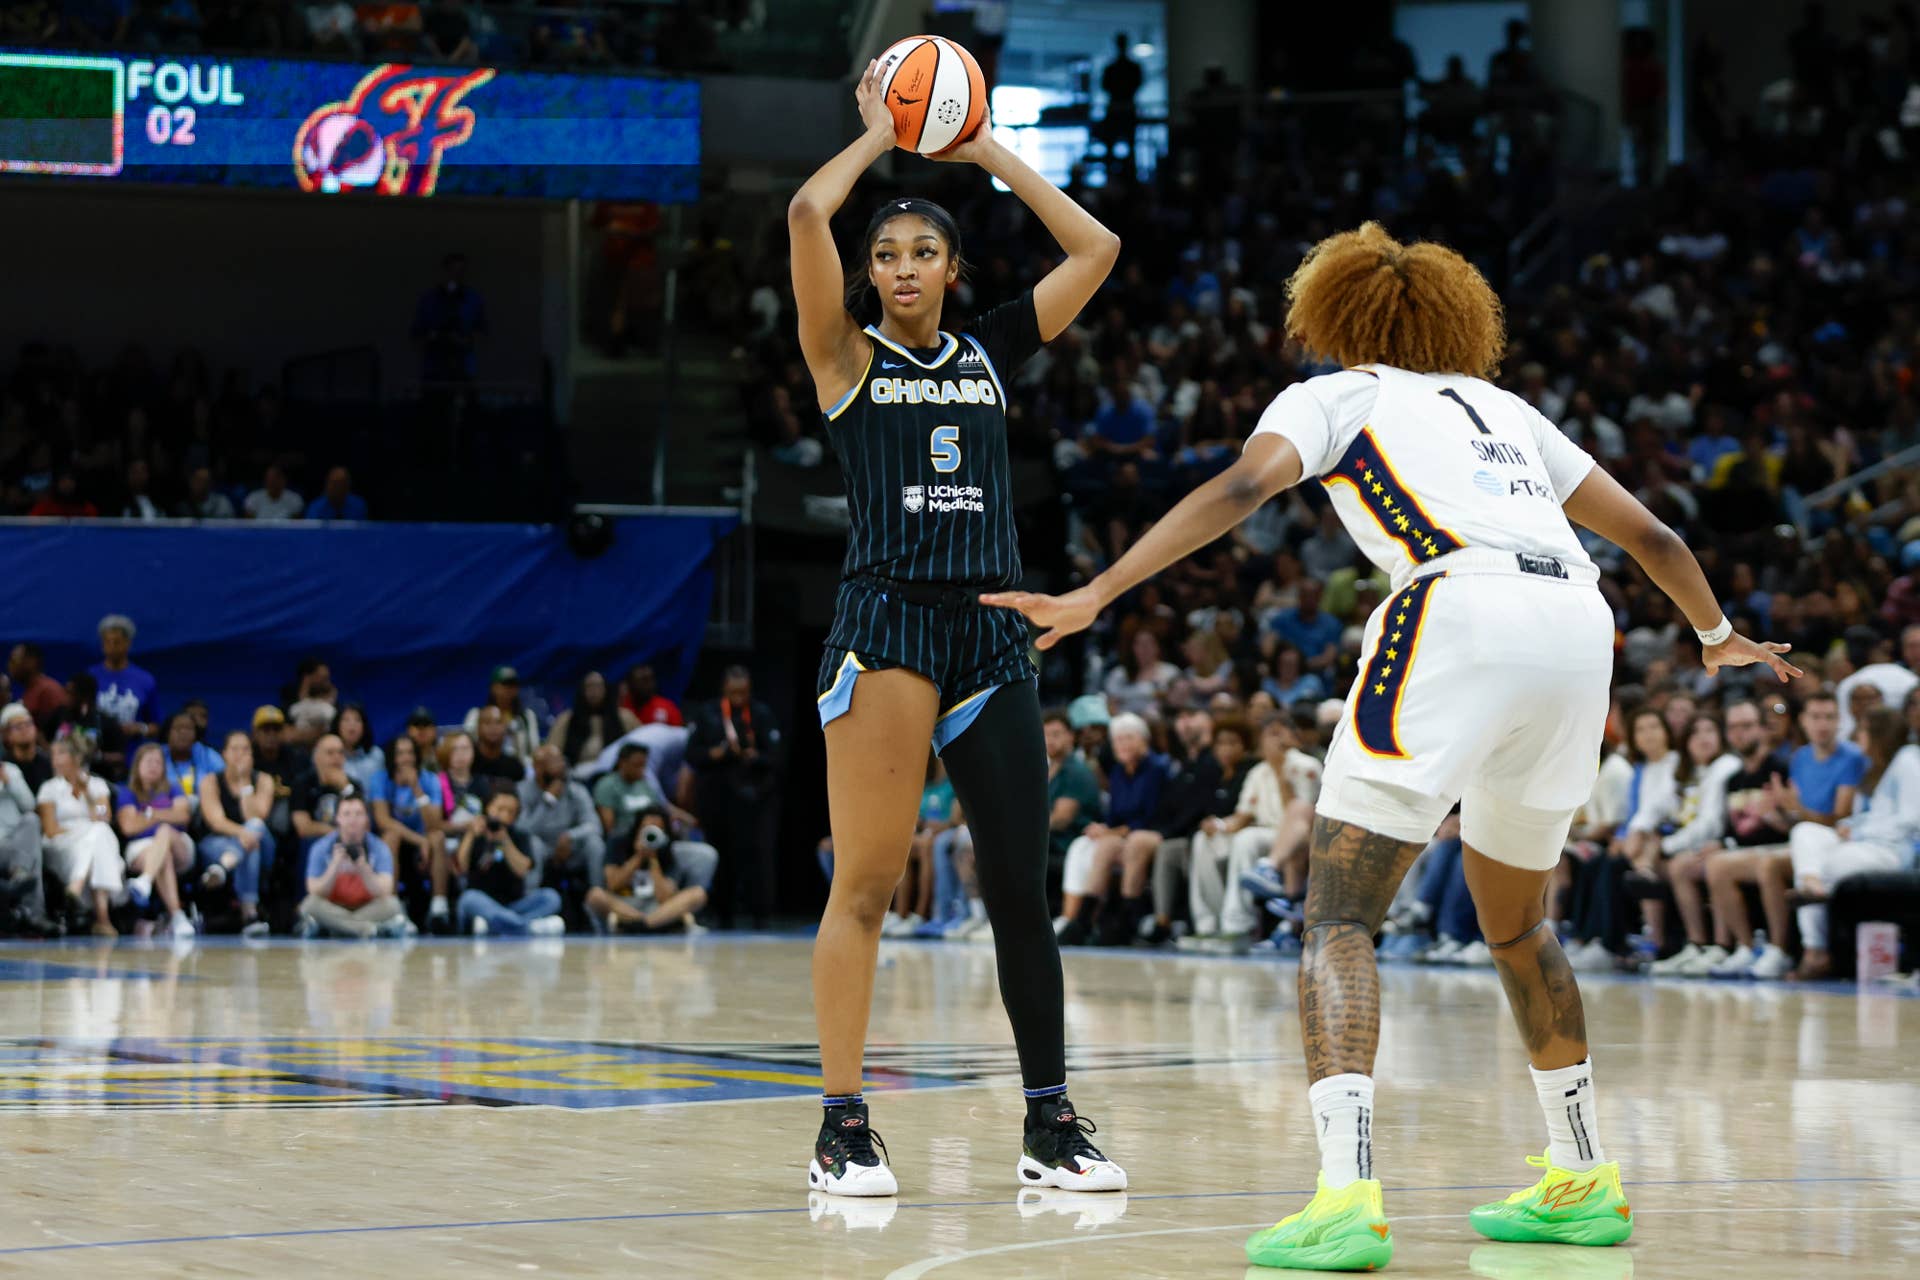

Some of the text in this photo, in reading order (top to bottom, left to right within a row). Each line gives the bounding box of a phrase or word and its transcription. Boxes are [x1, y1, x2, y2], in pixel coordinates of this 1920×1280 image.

[127, 59, 244, 105] FOUL
[145, 104, 196, 145] 02
[870, 377, 997, 406] CHICAGO
[1438, 387, 1493, 434] 1
[930, 425, 962, 473] 5
[1471, 440, 1527, 466] SMITH
[928, 485, 983, 499] UChicago
[928, 497, 985, 513] Medicine
